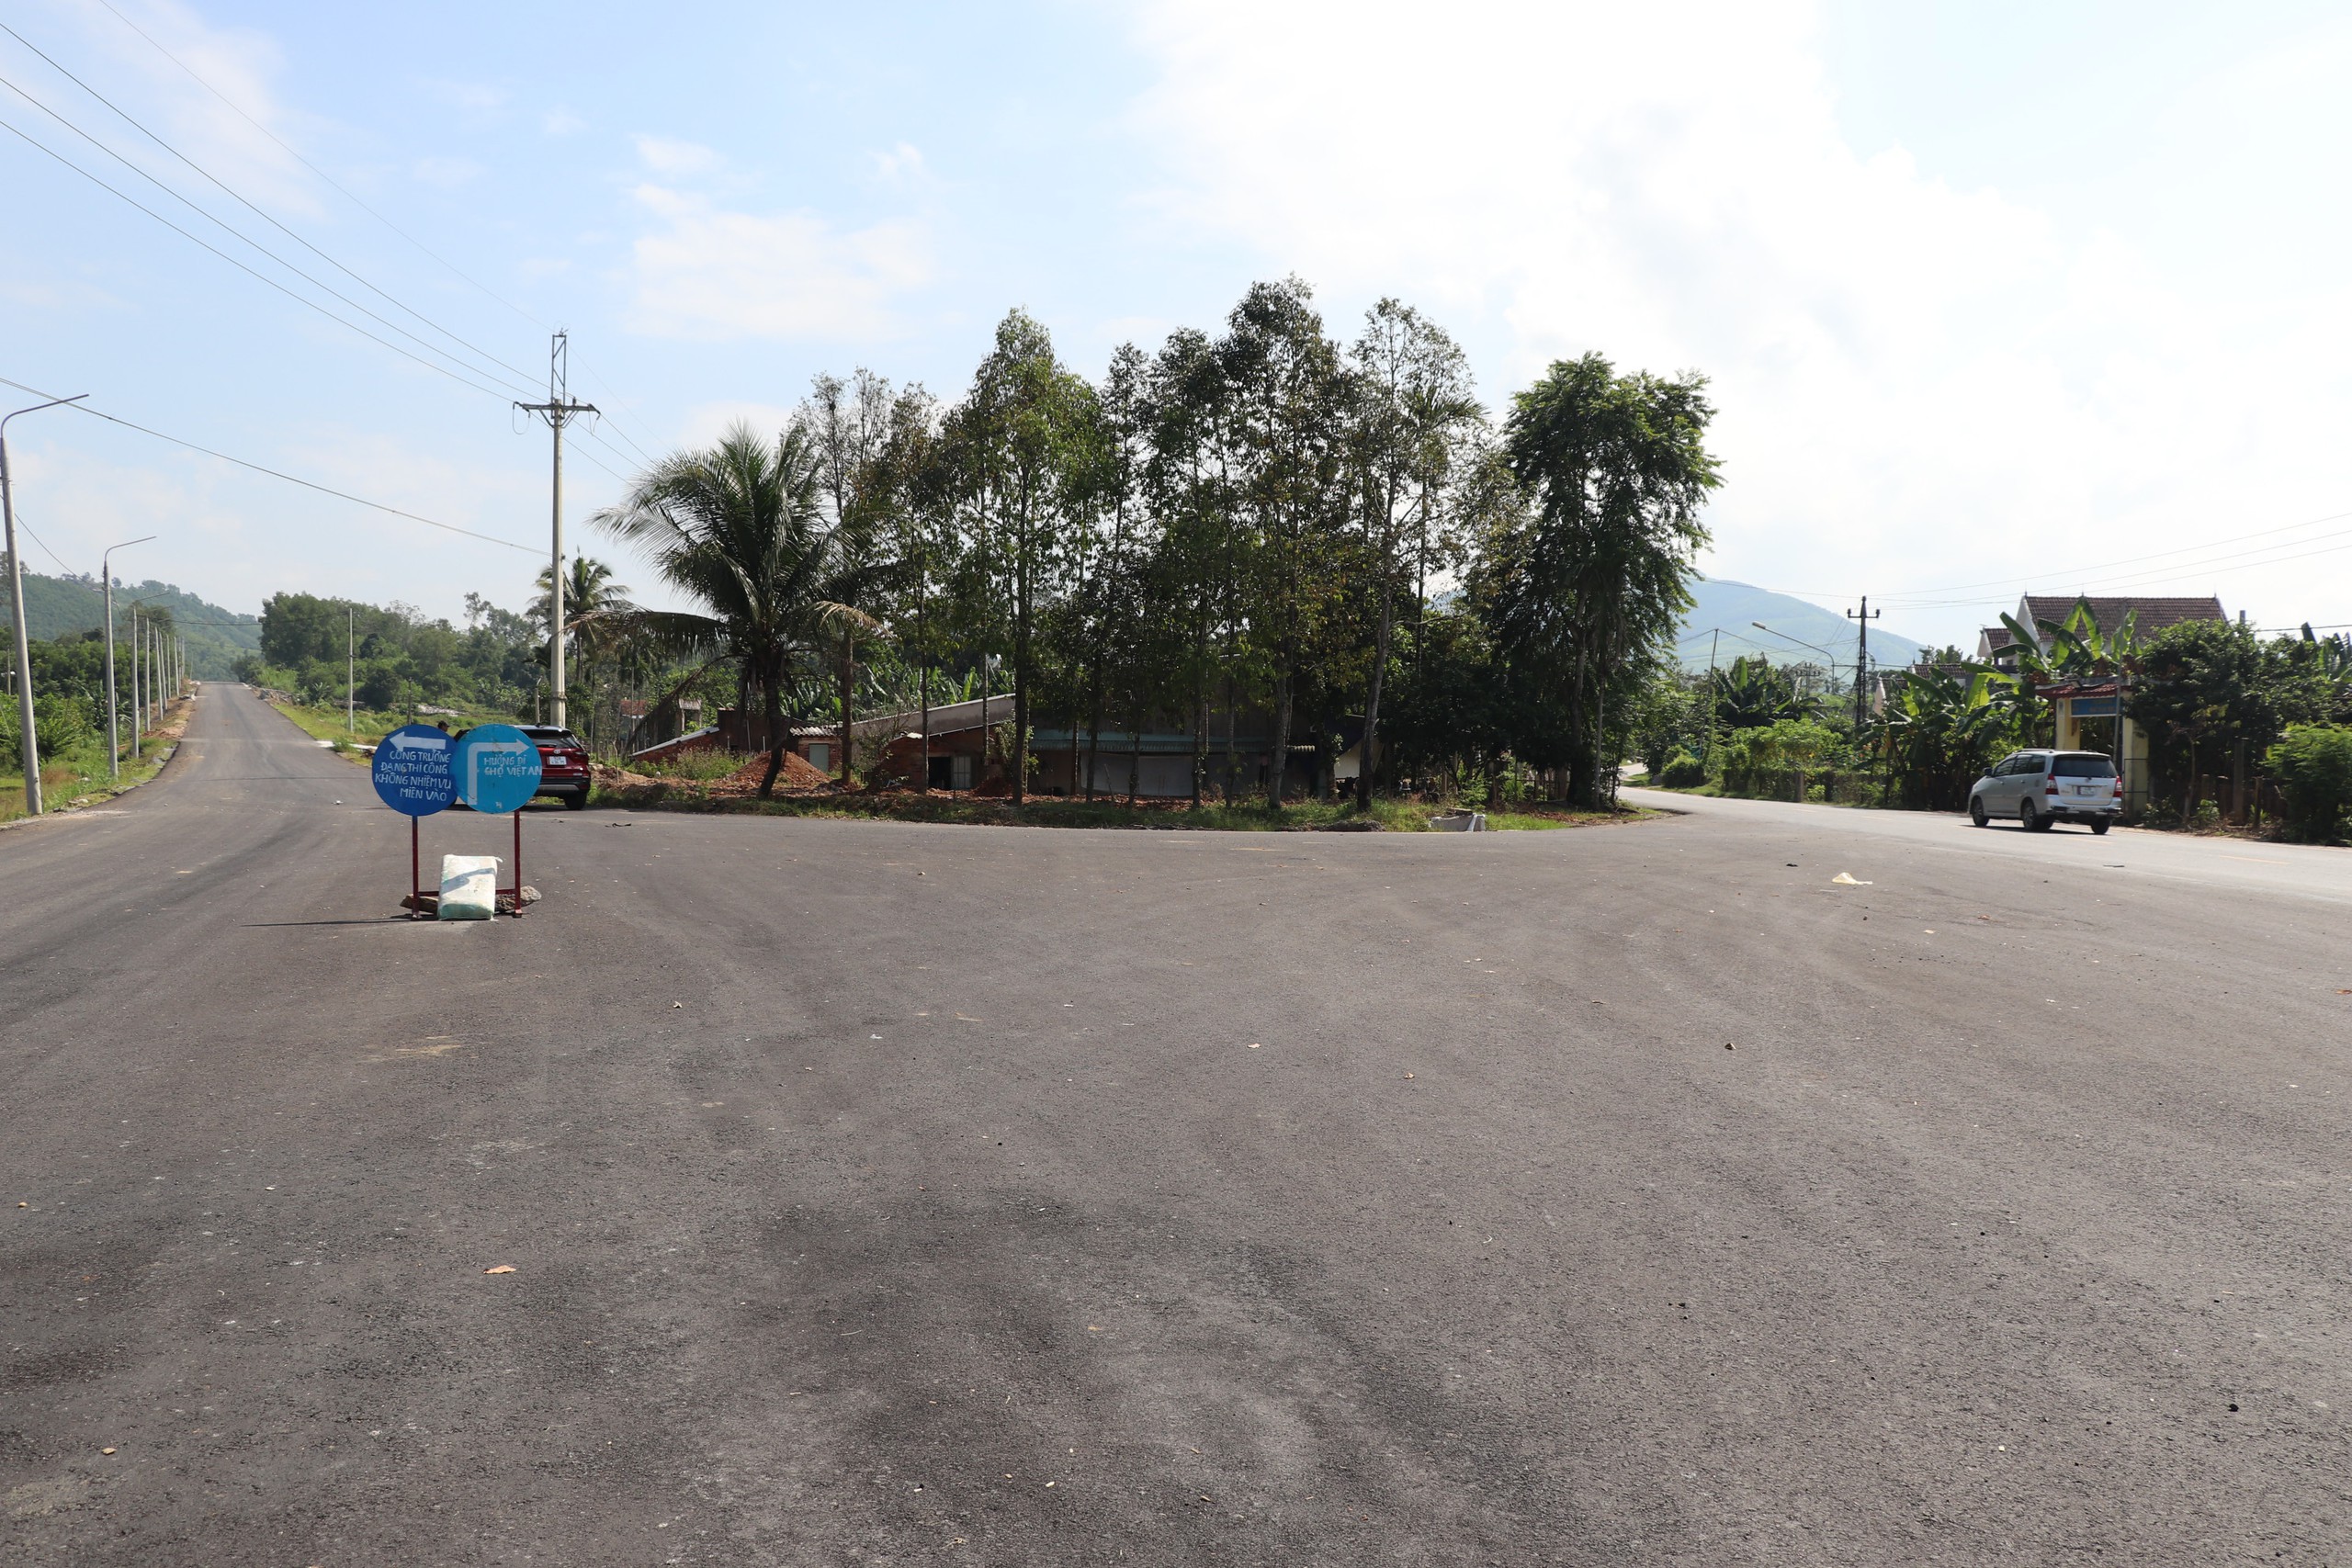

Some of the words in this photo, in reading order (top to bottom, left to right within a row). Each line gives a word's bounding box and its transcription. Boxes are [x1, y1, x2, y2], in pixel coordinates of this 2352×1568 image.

[407, 762, 422, 773] THI
[423, 762, 447, 774] CÔNG
[506, 765, 526, 777] VIỆT
[375, 772, 408, 784] KHÔNG
[425, 789, 447, 801] VÀO
